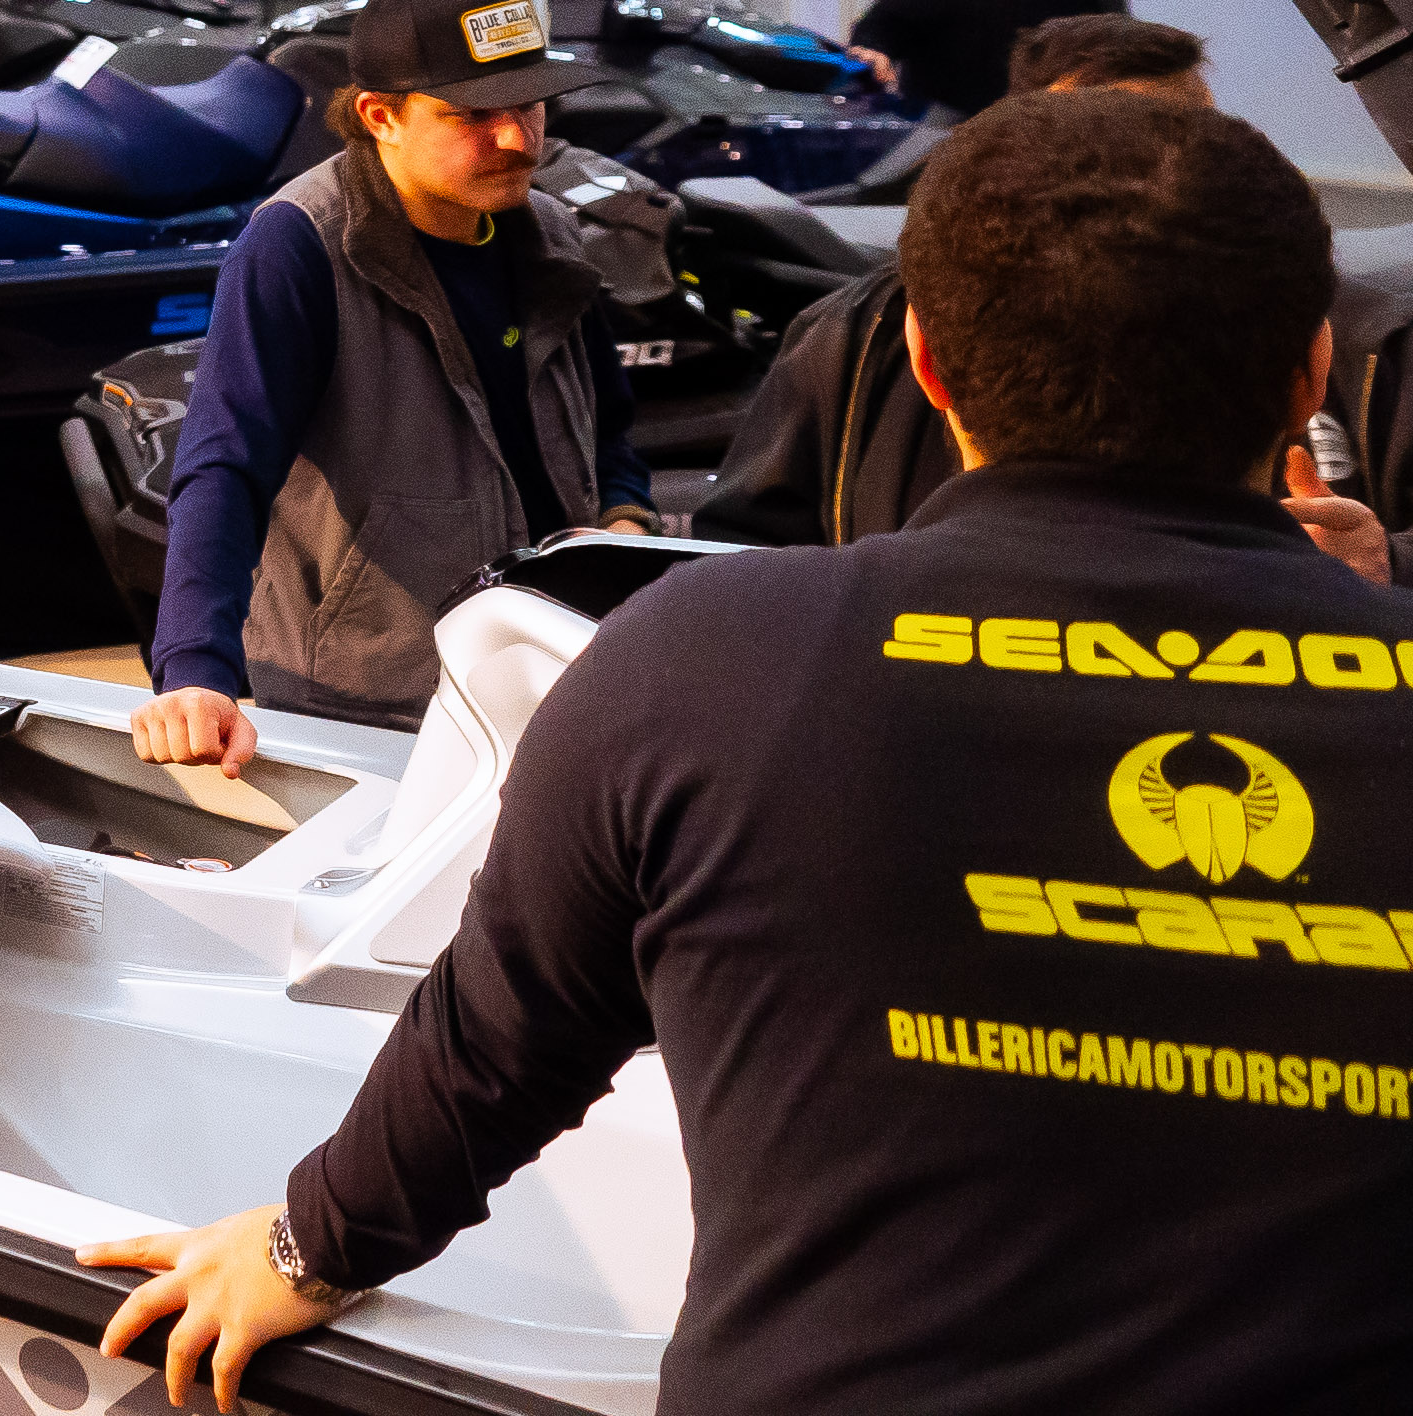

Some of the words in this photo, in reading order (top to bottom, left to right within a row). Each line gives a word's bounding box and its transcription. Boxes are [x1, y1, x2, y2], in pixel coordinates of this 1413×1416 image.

[469, 13, 502, 43] BLUE
[964, 872, 1413, 973] SCARA
[887, 1007, 1413, 1121] BILLERICAMOTORSPOR
